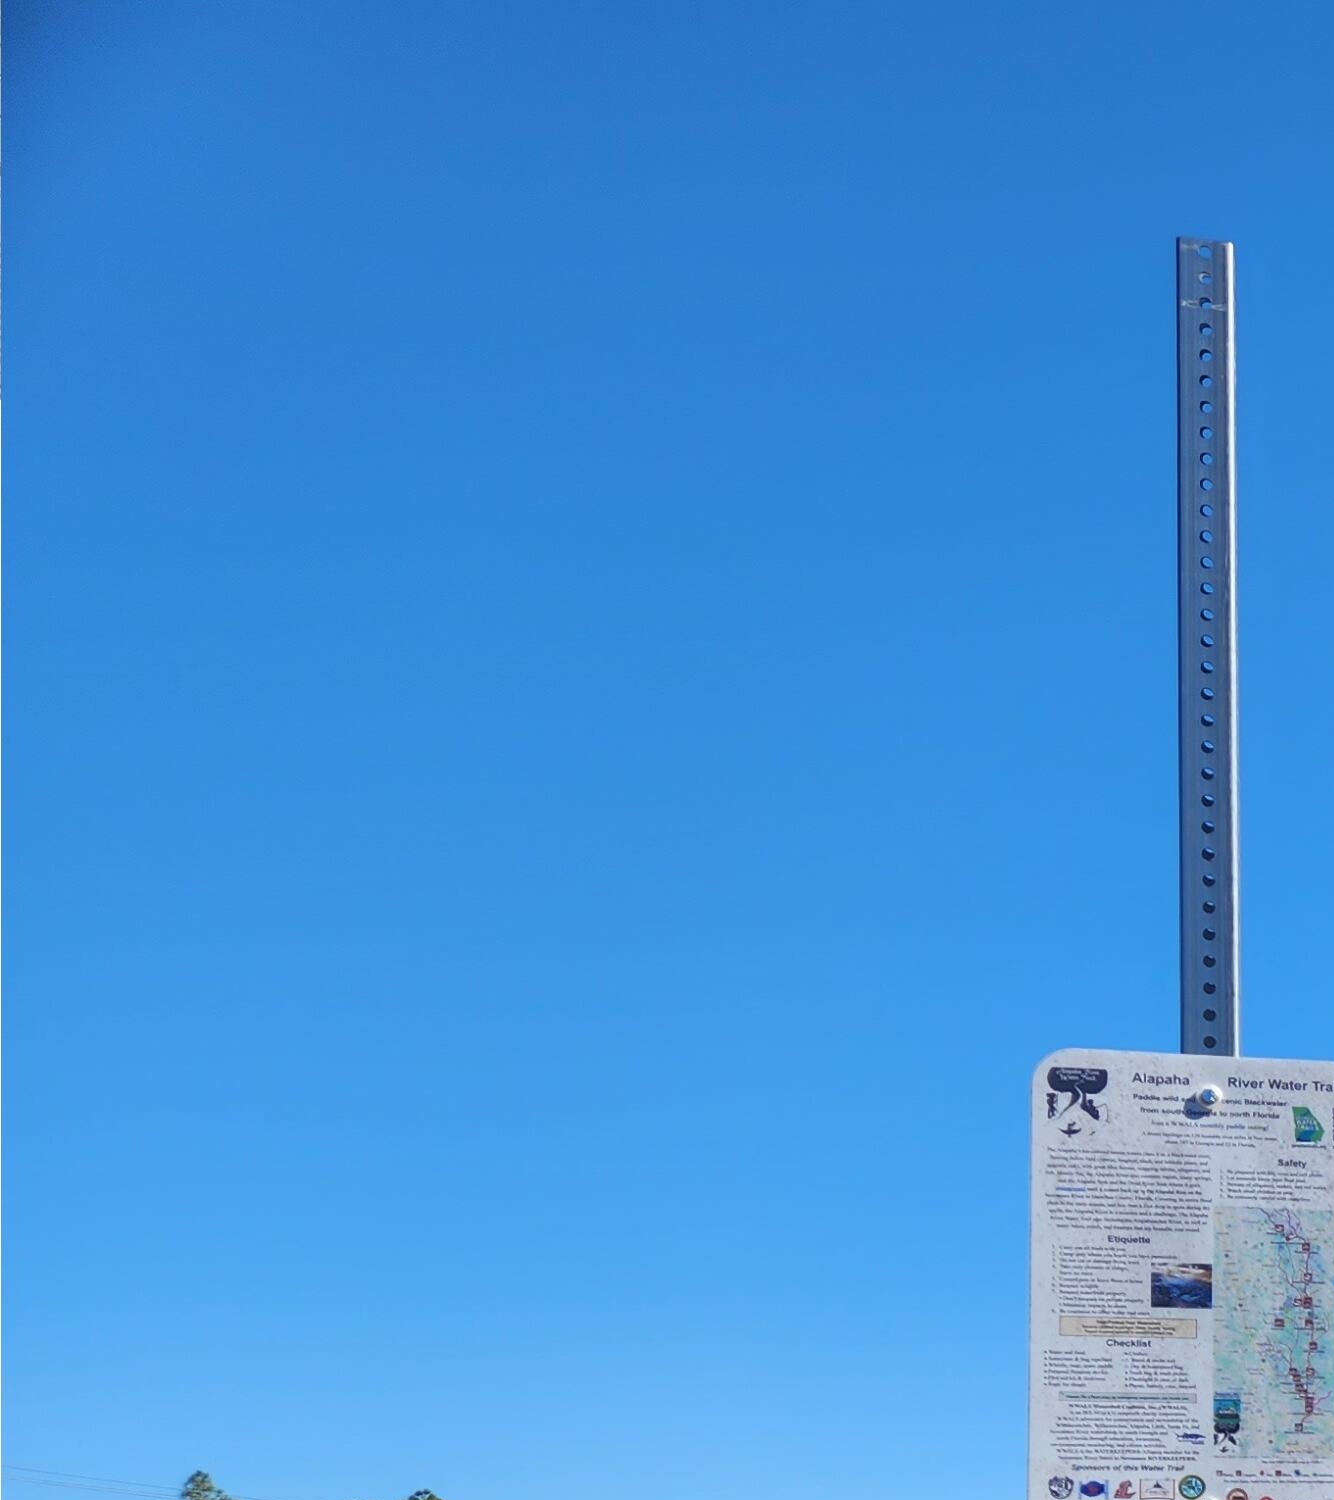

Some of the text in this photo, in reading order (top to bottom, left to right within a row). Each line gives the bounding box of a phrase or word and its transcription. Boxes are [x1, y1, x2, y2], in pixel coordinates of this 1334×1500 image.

[1132, 1072, 1190, 1086] Alapaha
[1227, 1076, 1264, 1089] River
[1267, 1078, 1308, 1091] Water
[1133, 1093, 1160, 1101] Paddle
[1244, 1098, 1287, 1107] Blackwater
[1162, 1107, 1184, 1115] south
[1229, 1110, 1250, 1118] north
[1253, 1111, 1280, 1120] Florida
[1277, 1158, 1307, 1169] Safety
[1107, 1234, 1150, 1245] Etiquette
[1106, 1338, 1152, 1349] Checklist
[1071, 1463, 1185, 1472] Sponsors of this Water Trail
